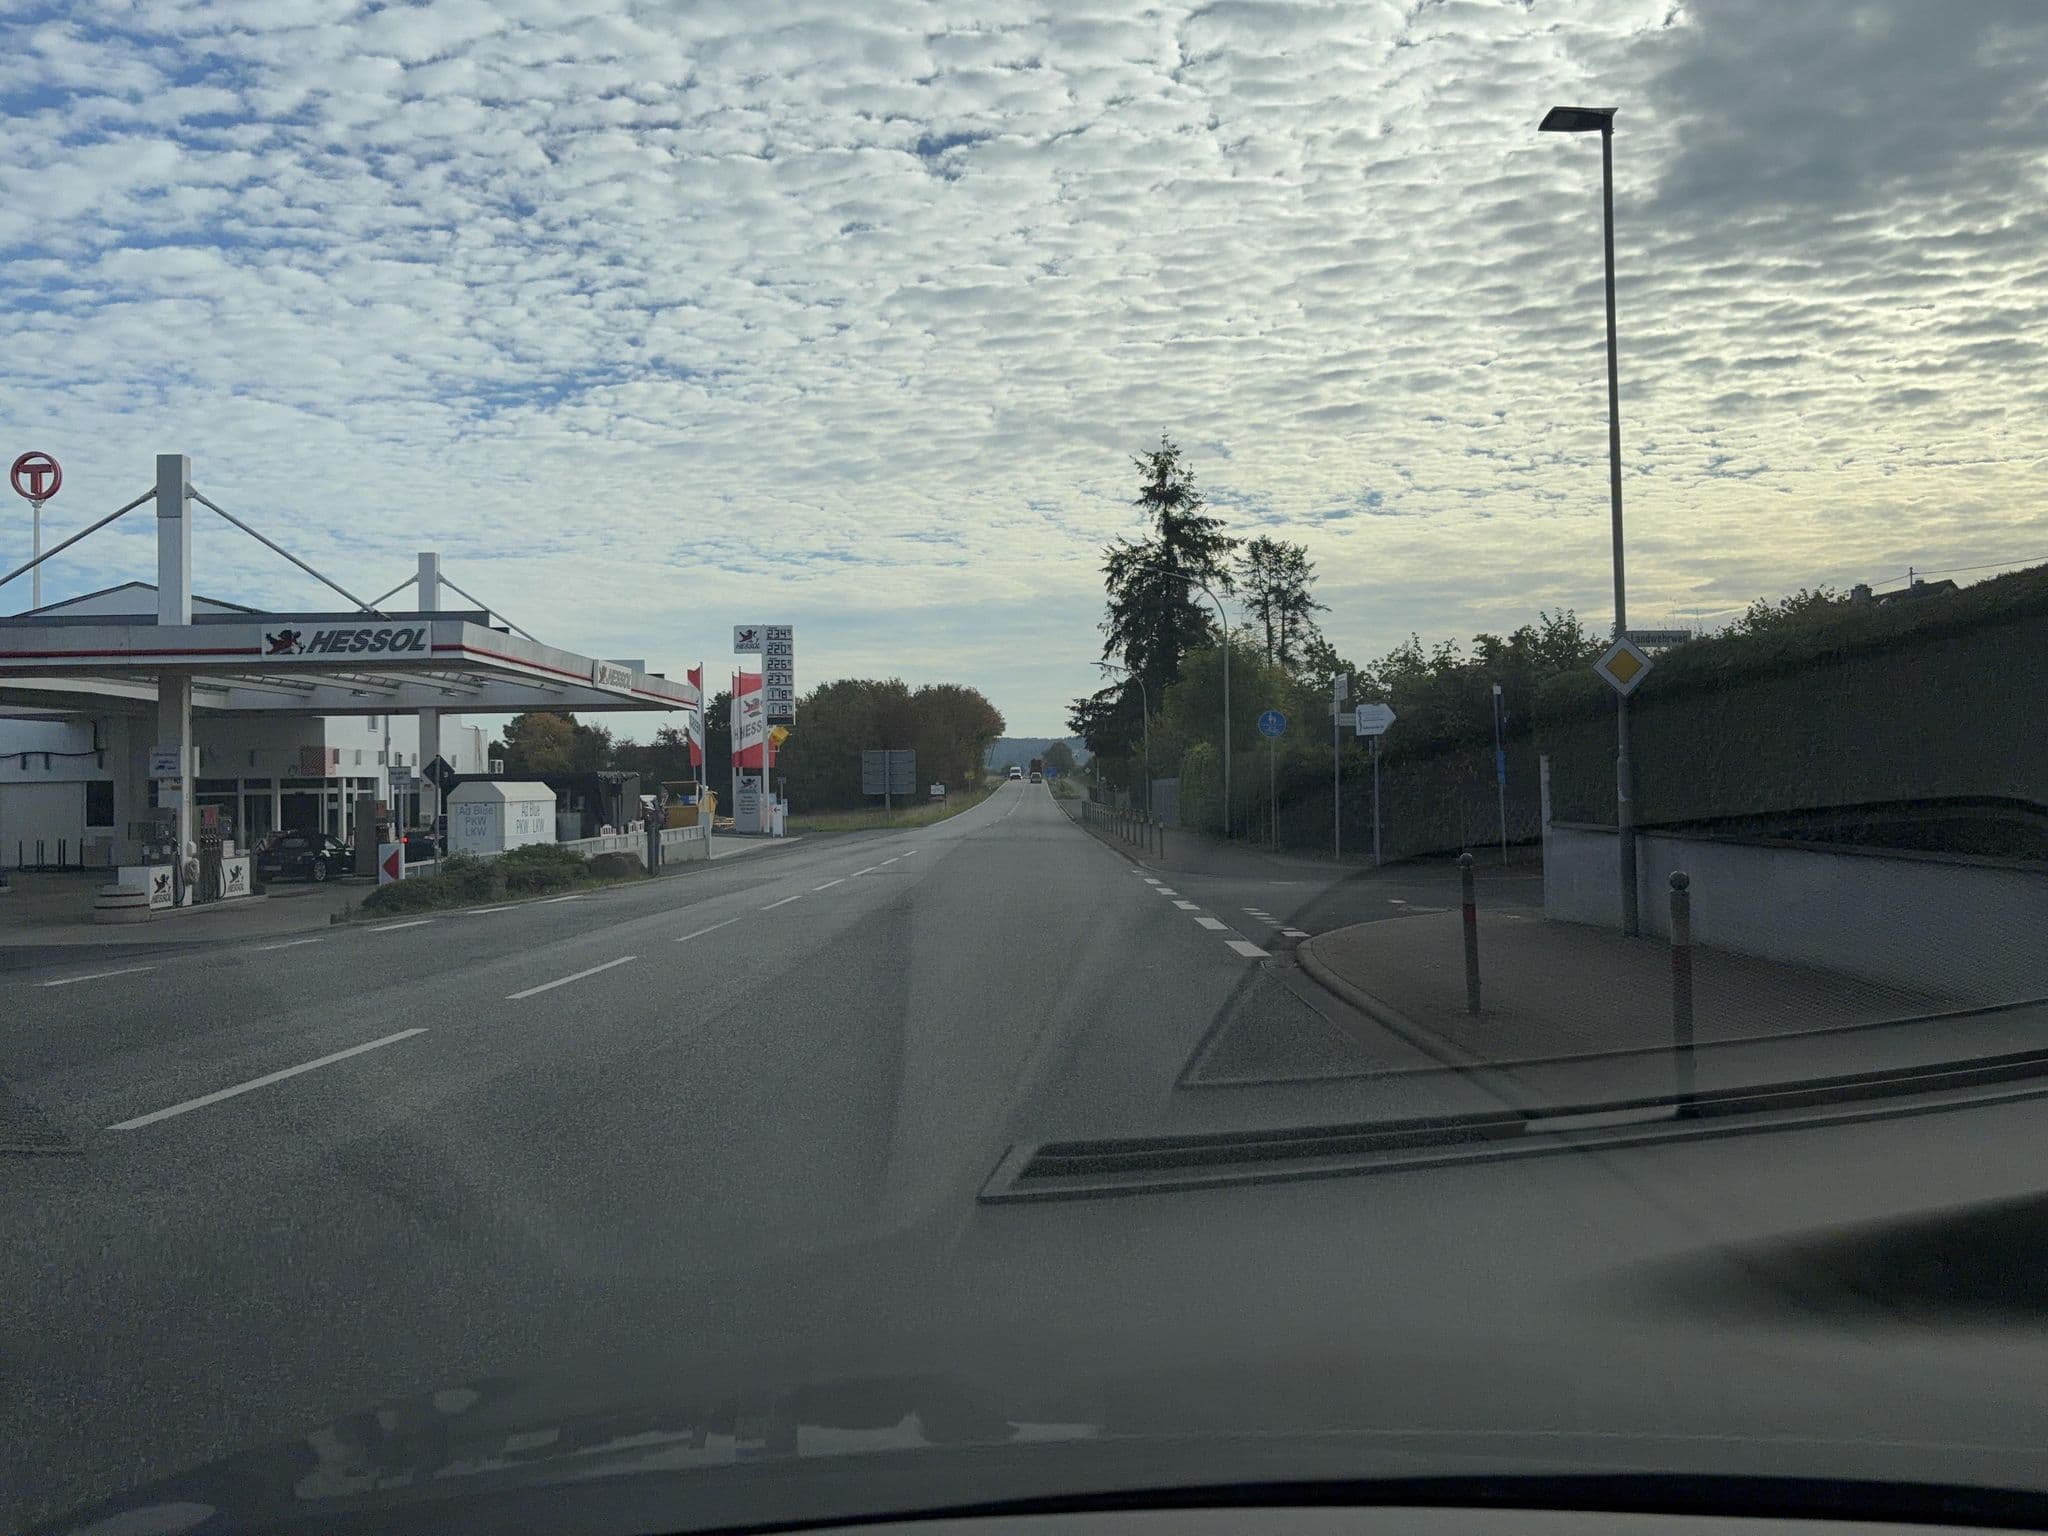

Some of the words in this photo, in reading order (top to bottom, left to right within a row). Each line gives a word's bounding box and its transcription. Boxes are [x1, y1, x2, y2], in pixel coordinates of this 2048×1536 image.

[306, 628, 427, 654] HESSOL
[740, 719, 762, 738] HESS
[465, 816, 487, 826] PKW
[465, 827, 487, 837] LKW
